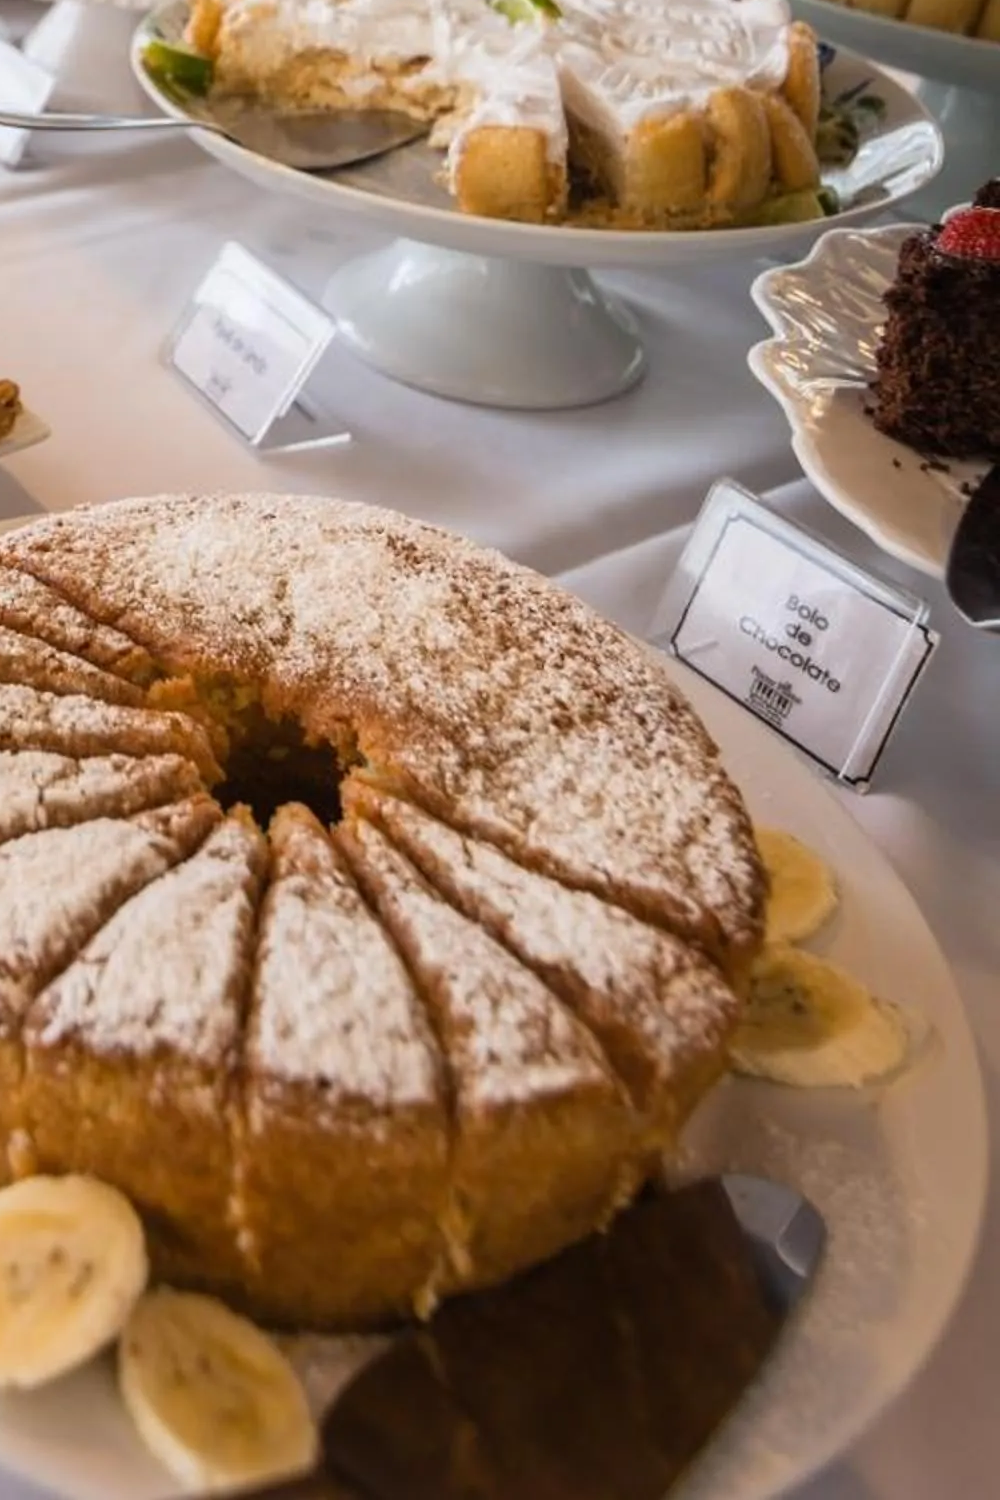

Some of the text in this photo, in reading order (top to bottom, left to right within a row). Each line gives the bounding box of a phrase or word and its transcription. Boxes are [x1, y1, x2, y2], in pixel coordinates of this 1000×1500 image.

[785, 594, 829, 631] Bolo
[786, 622, 812, 647] de
[739, 615, 841, 693] Chocolate
